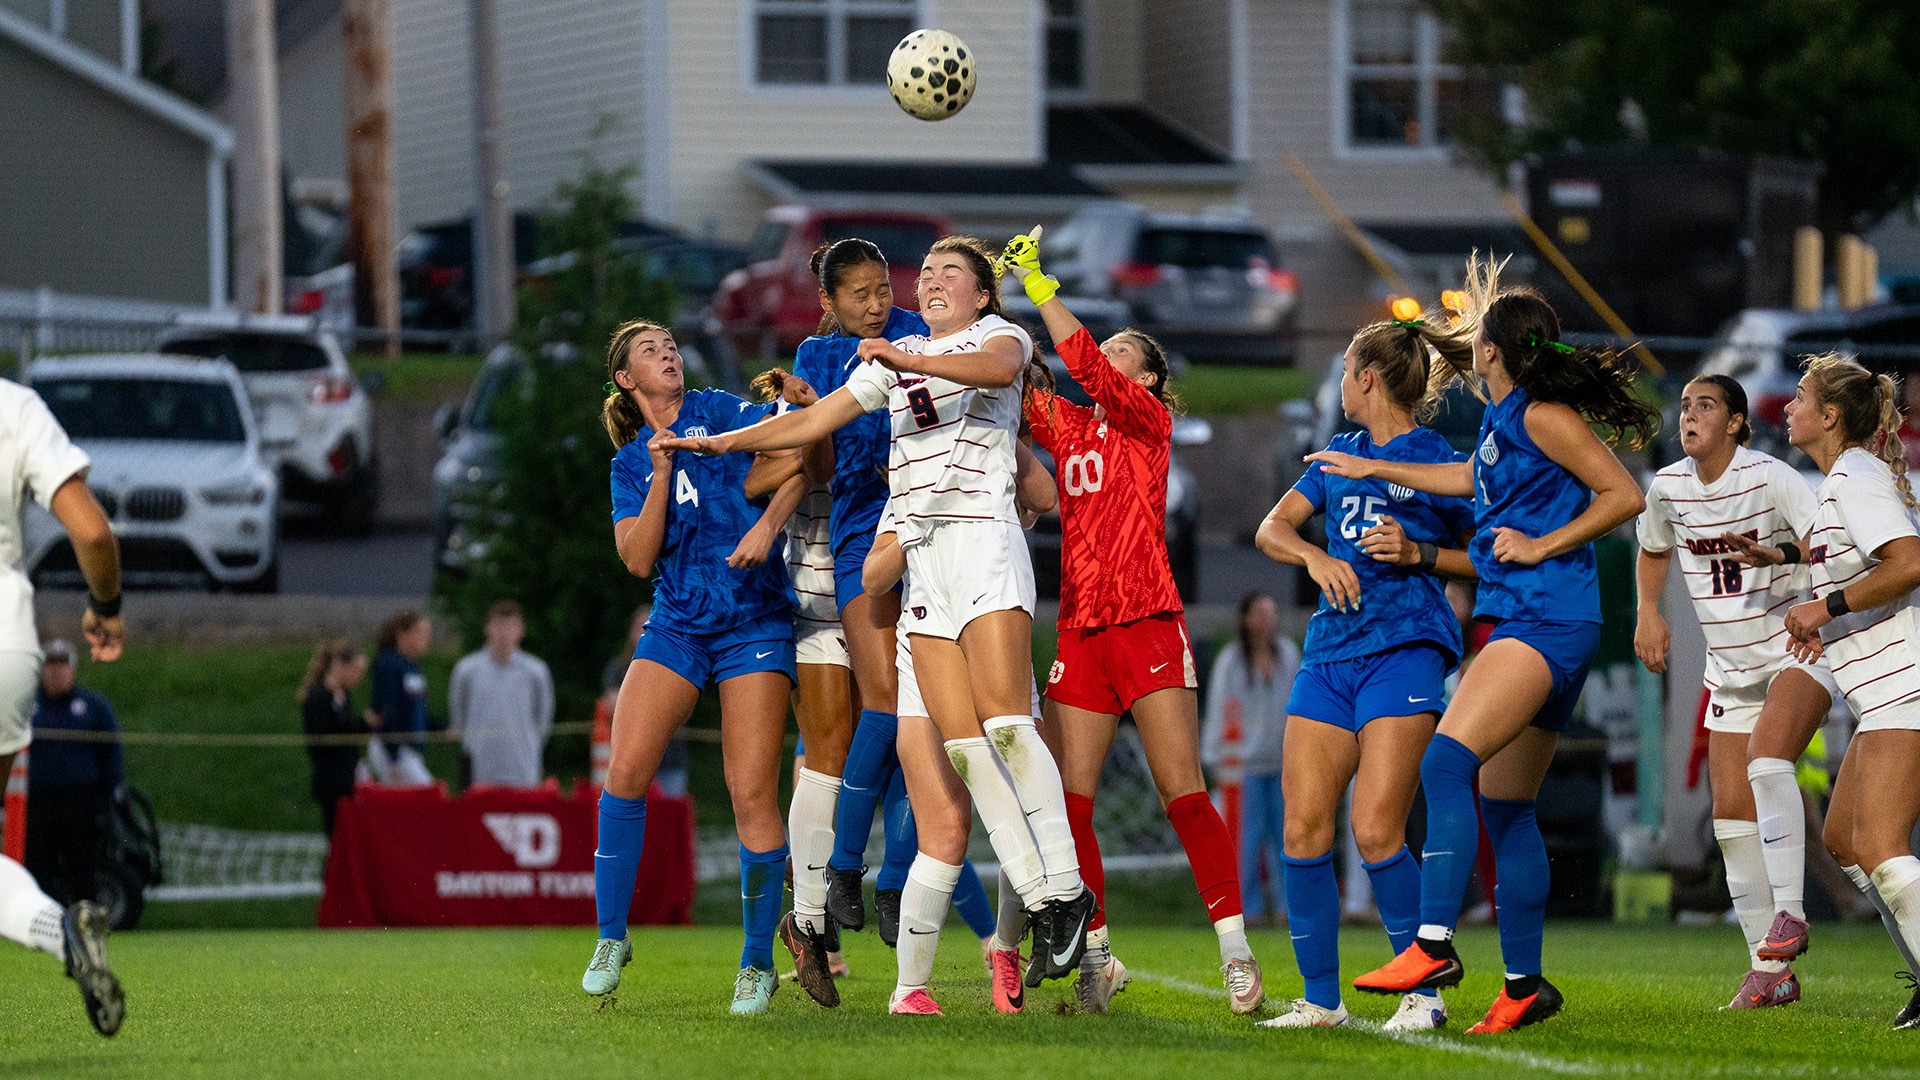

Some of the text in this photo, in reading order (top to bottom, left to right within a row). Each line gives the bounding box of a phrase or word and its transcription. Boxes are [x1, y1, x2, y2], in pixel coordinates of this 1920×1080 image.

[907, 387, 940, 428] 9
[675, 469, 699, 508] 4
[1065, 450, 1104, 496] 00
[1341, 495, 1387, 540] 25
[1710, 558, 1743, 595] 18
[434, 870, 534, 898] DAYTON
